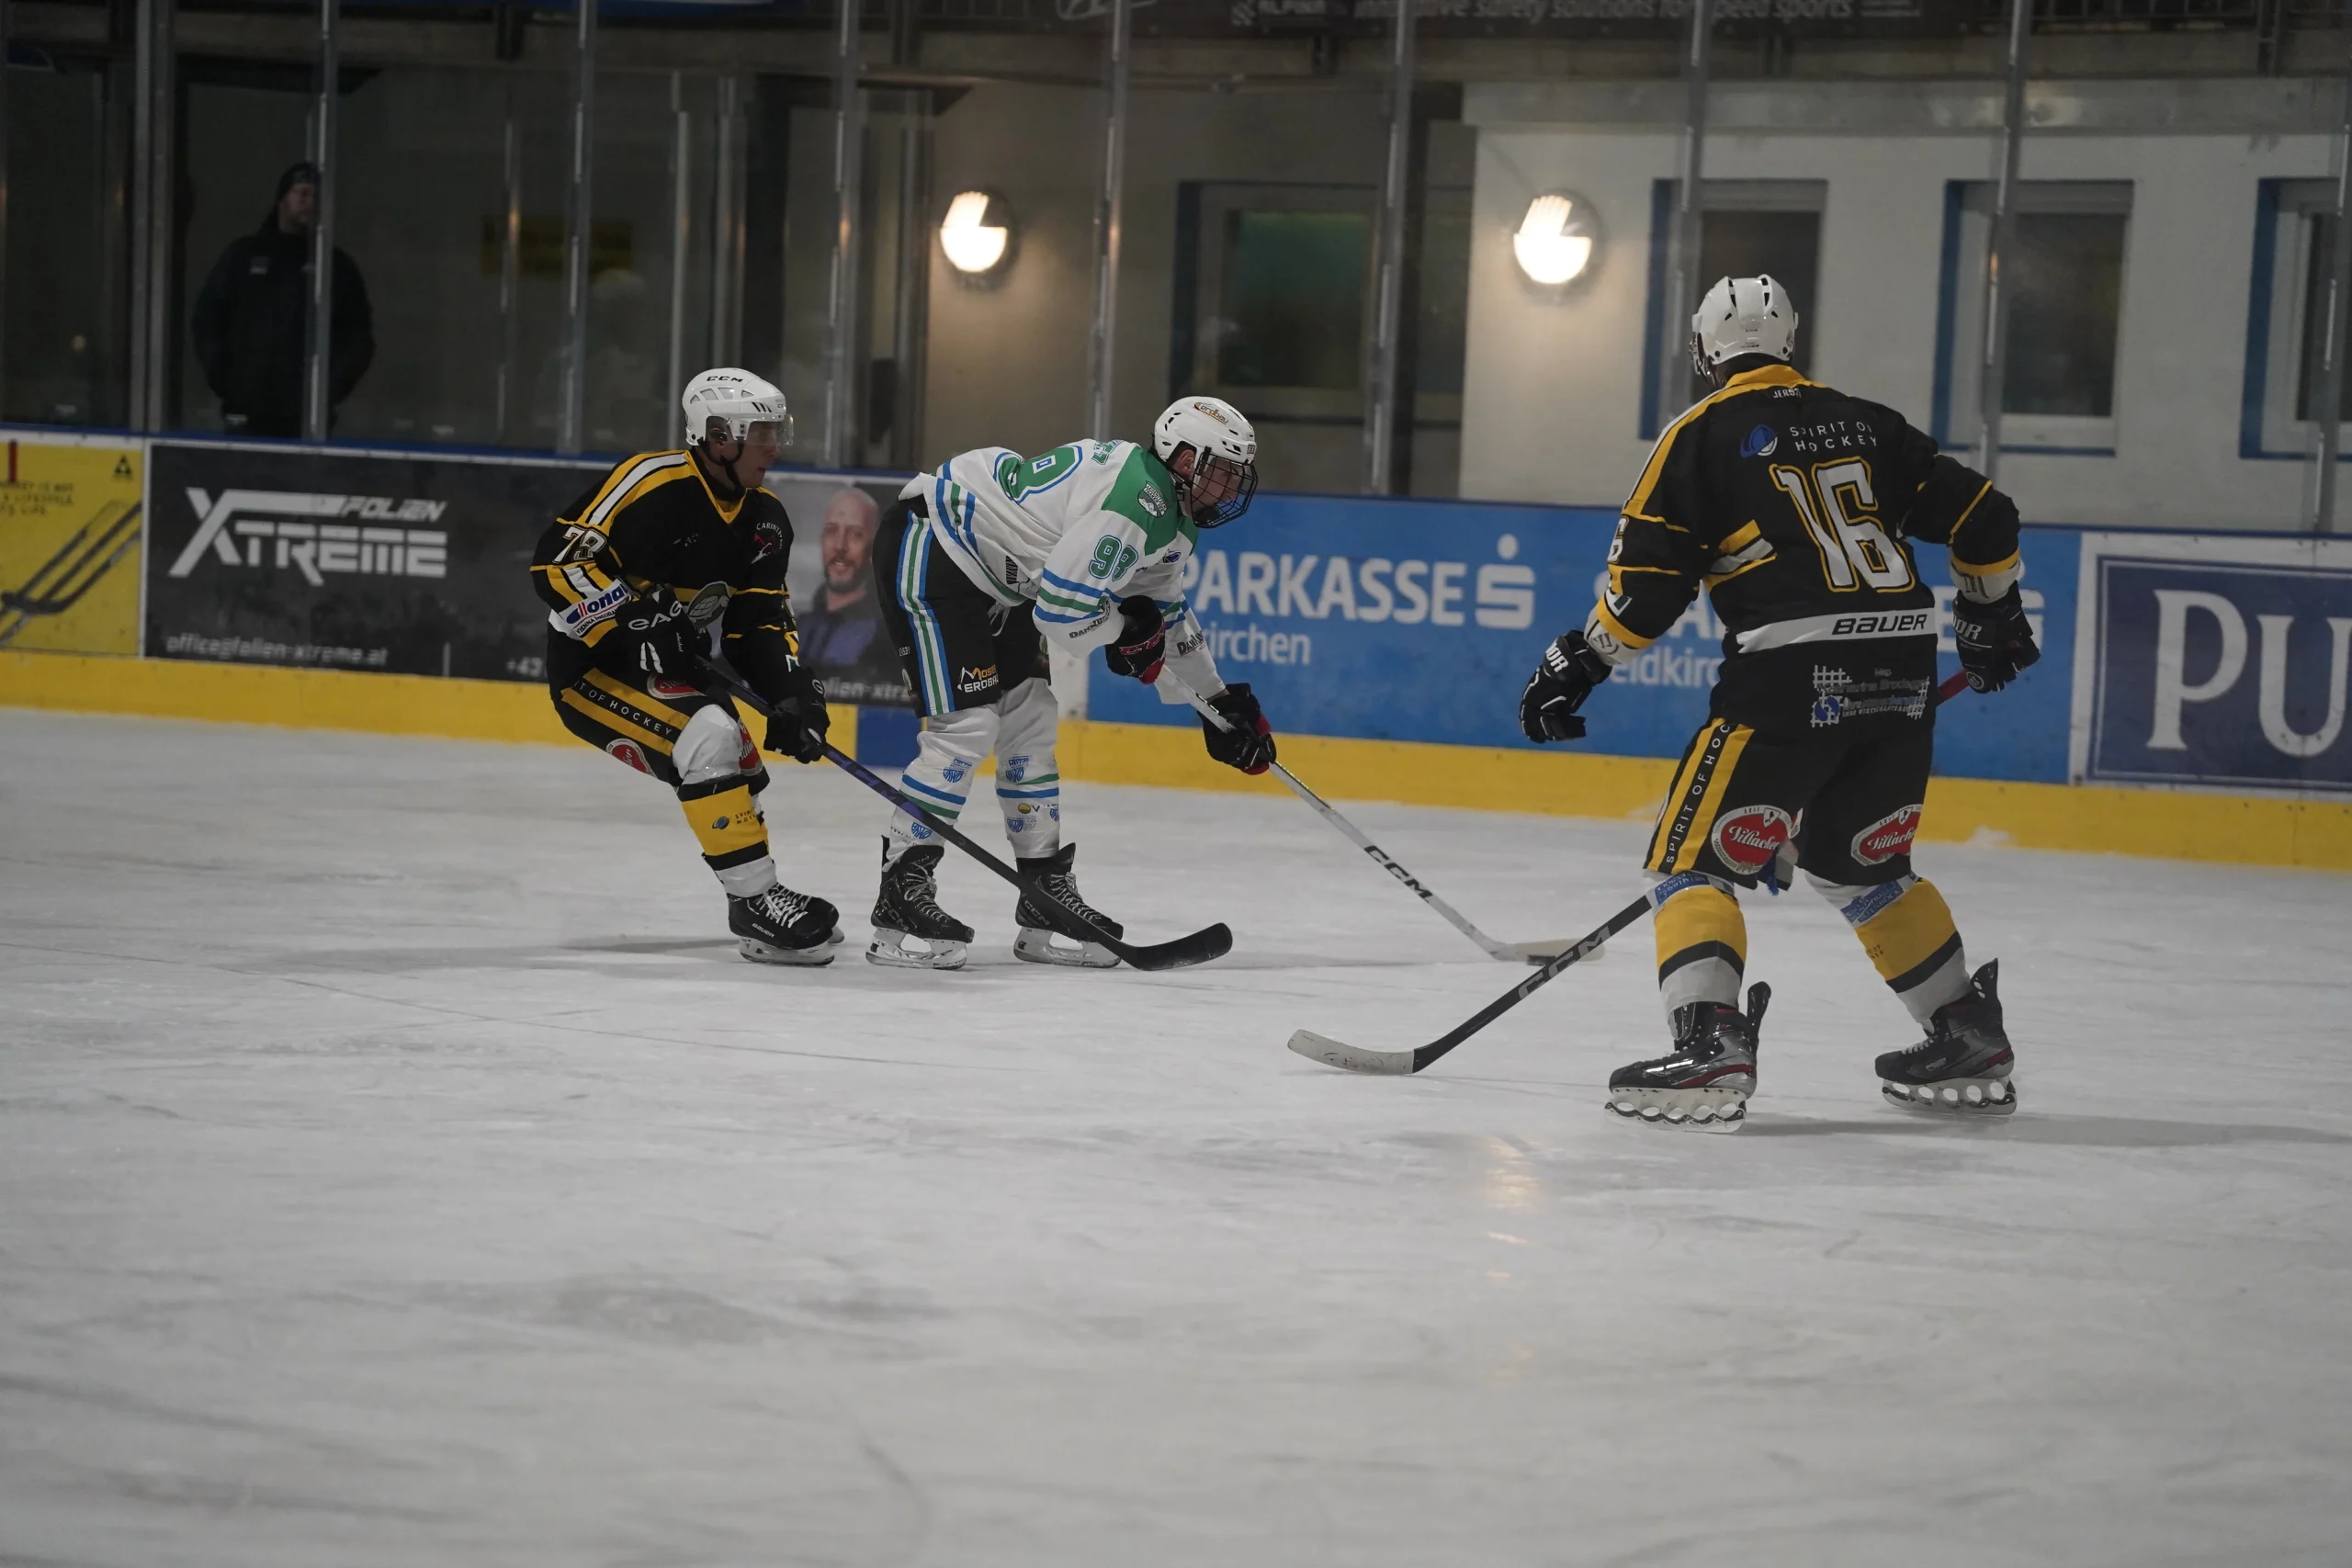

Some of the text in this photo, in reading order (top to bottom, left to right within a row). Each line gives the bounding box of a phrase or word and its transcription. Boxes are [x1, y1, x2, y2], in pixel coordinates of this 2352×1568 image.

[1794, 434, 1877, 452] HOCKEY
[1856, 421, 1872, 434] O
[167, 486, 448, 586] XTREME
[1769, 456, 1916, 592] 16
[1089, 535, 1139, 582] 98
[1832, 614, 1928, 636] BAUER
[610, 700, 673, 736] HOCKEY
[1667, 805, 1693, 863] SPIRIT
[1692, 773, 1707, 795] OF
[1363, 844, 1433, 903] CCM
[1518, 925, 1611, 999] CCM
